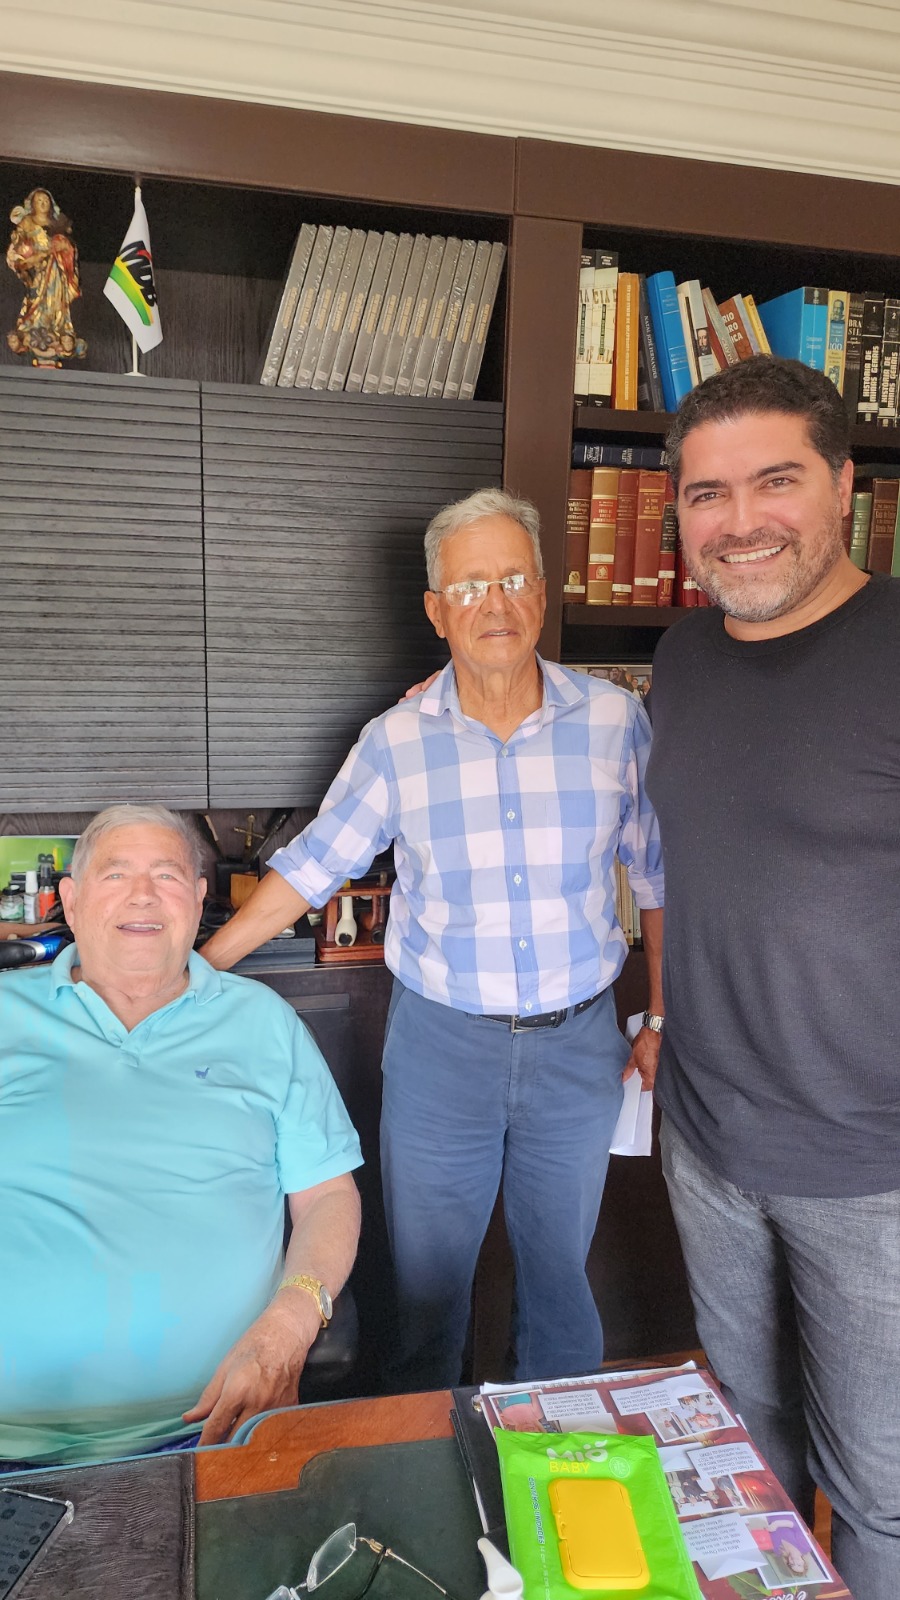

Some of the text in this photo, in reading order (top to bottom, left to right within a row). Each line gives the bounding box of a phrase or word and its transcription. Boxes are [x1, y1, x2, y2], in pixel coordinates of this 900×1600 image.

[863, 350, 872, 397] HISTÓRIA DE
[870, 346, 879, 402] MINAS GERAIS
[884, 356, 891, 366] DE
[549, 1461, 590, 1474] BABY
[535, 1511, 545, 1544] UNIDADES
